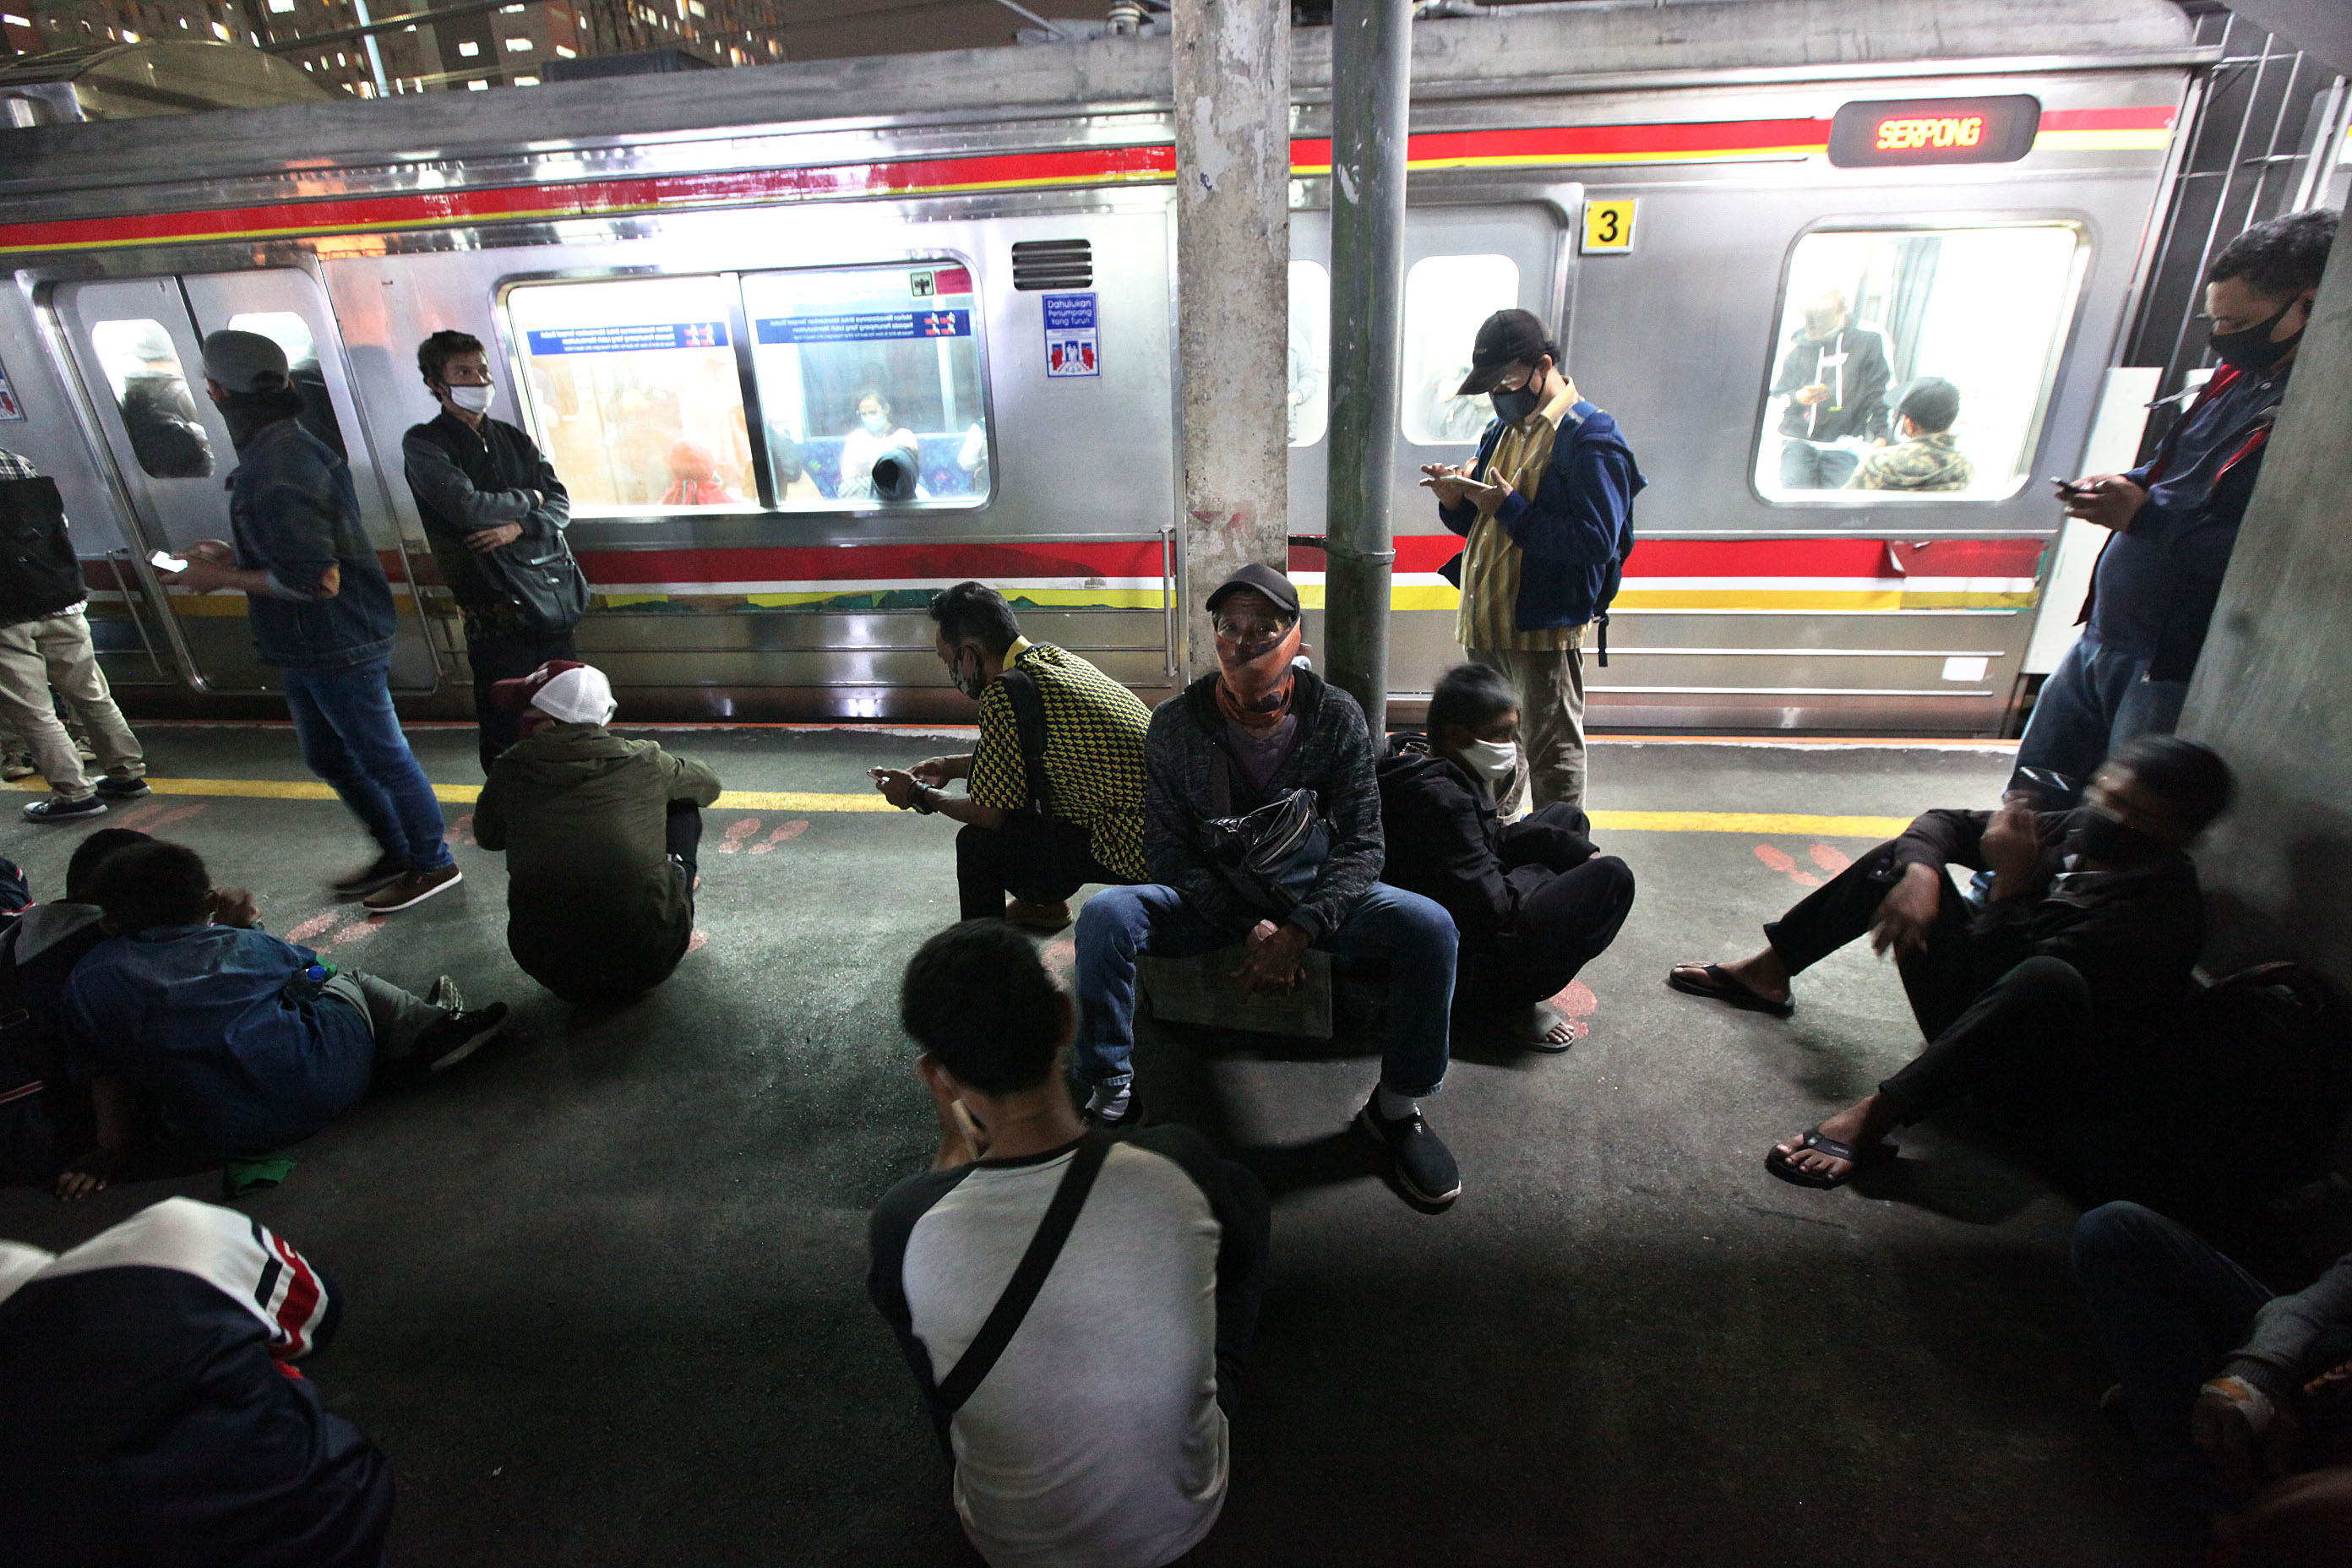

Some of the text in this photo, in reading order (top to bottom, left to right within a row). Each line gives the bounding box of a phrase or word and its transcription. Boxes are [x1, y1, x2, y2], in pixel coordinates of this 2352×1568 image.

[1876, 117, 1982, 150] SERPONG
[1598, 209, 1619, 242] 3
[1048, 299, 1092, 309] Dahulukan
[1048, 309, 1092, 318] Penumpang
